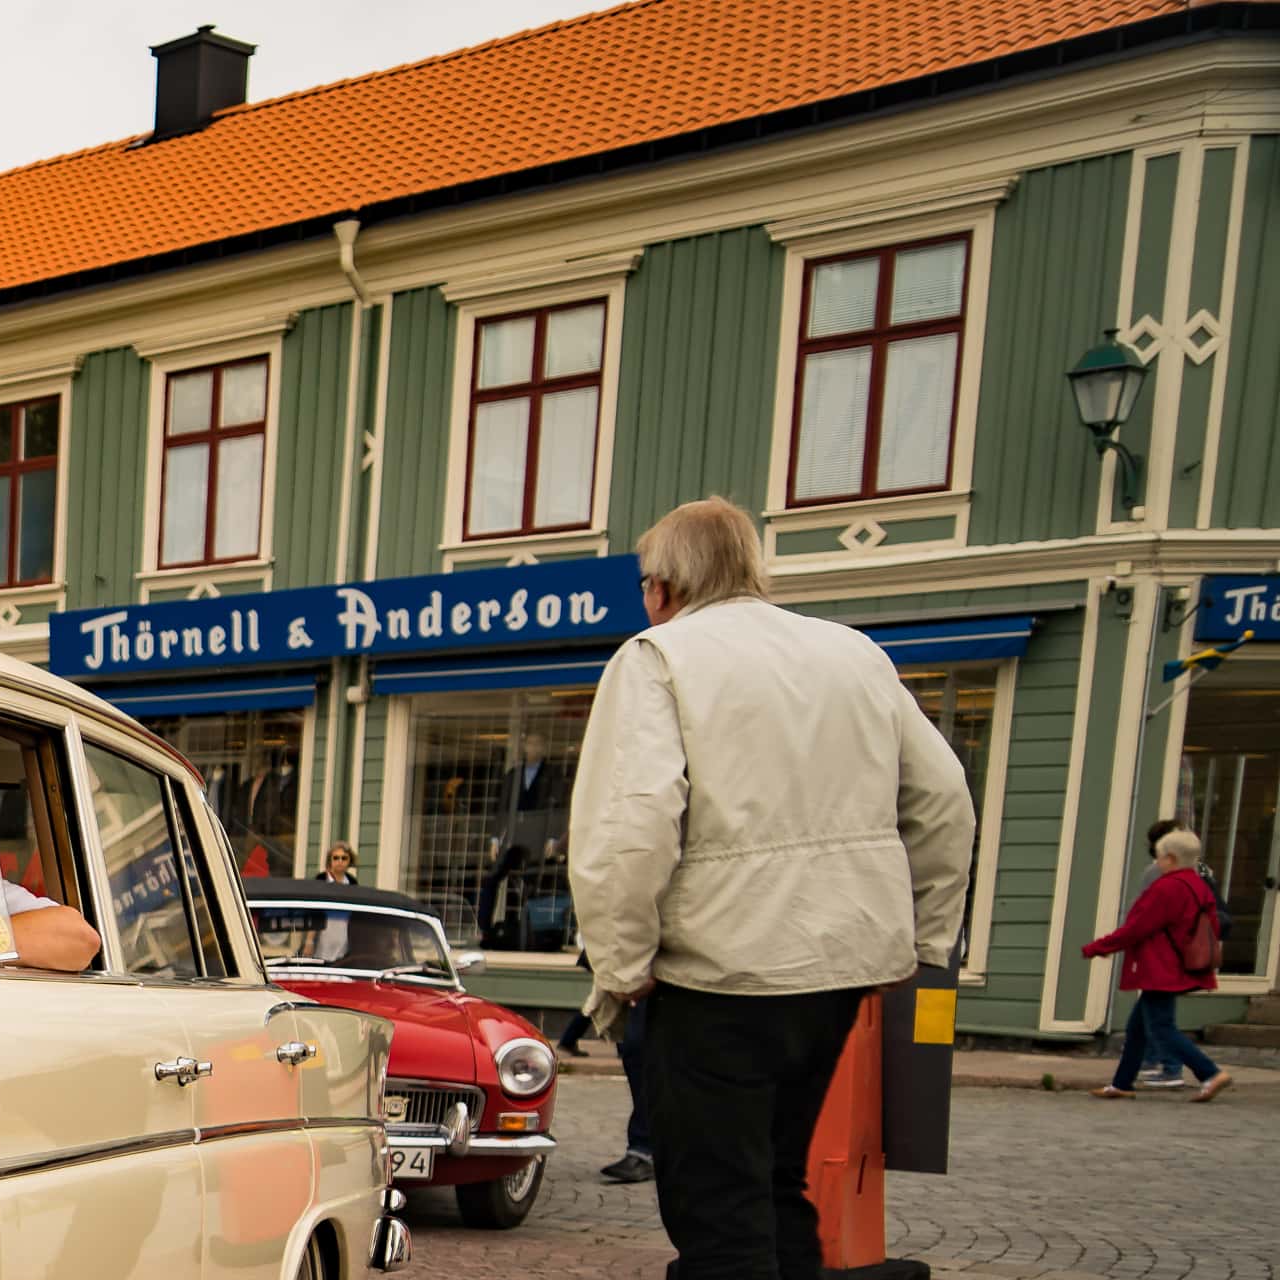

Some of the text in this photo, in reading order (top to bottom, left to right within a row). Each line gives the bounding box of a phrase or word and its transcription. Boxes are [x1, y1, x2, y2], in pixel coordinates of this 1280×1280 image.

[80, 588, 608, 670] Thörnell & Anderson
